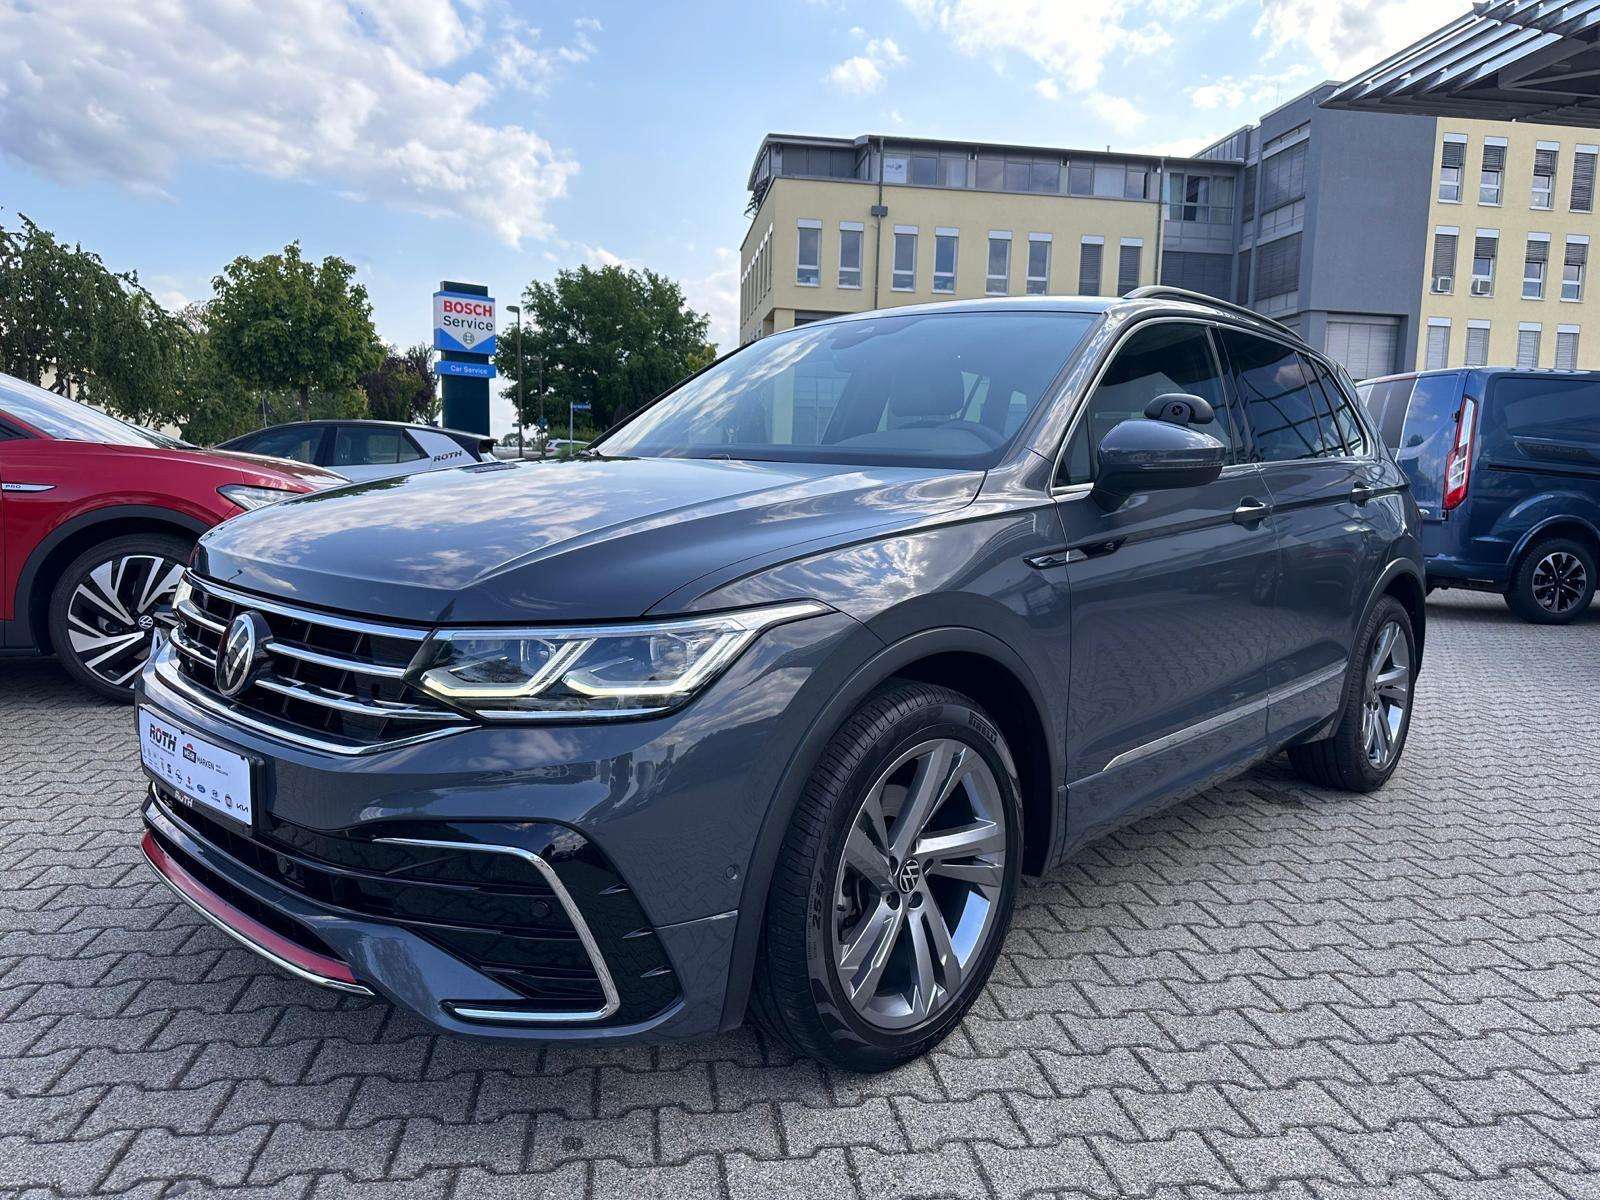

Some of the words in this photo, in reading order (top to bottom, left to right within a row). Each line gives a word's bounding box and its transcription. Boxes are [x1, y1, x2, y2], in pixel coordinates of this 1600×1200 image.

[443, 300, 492, 317] BOSCH
[443, 315, 493, 331] Service
[463, 366, 488, 375] Service
[433, 450, 462, 462] ROTH
[149, 722, 177, 752] ROTH
